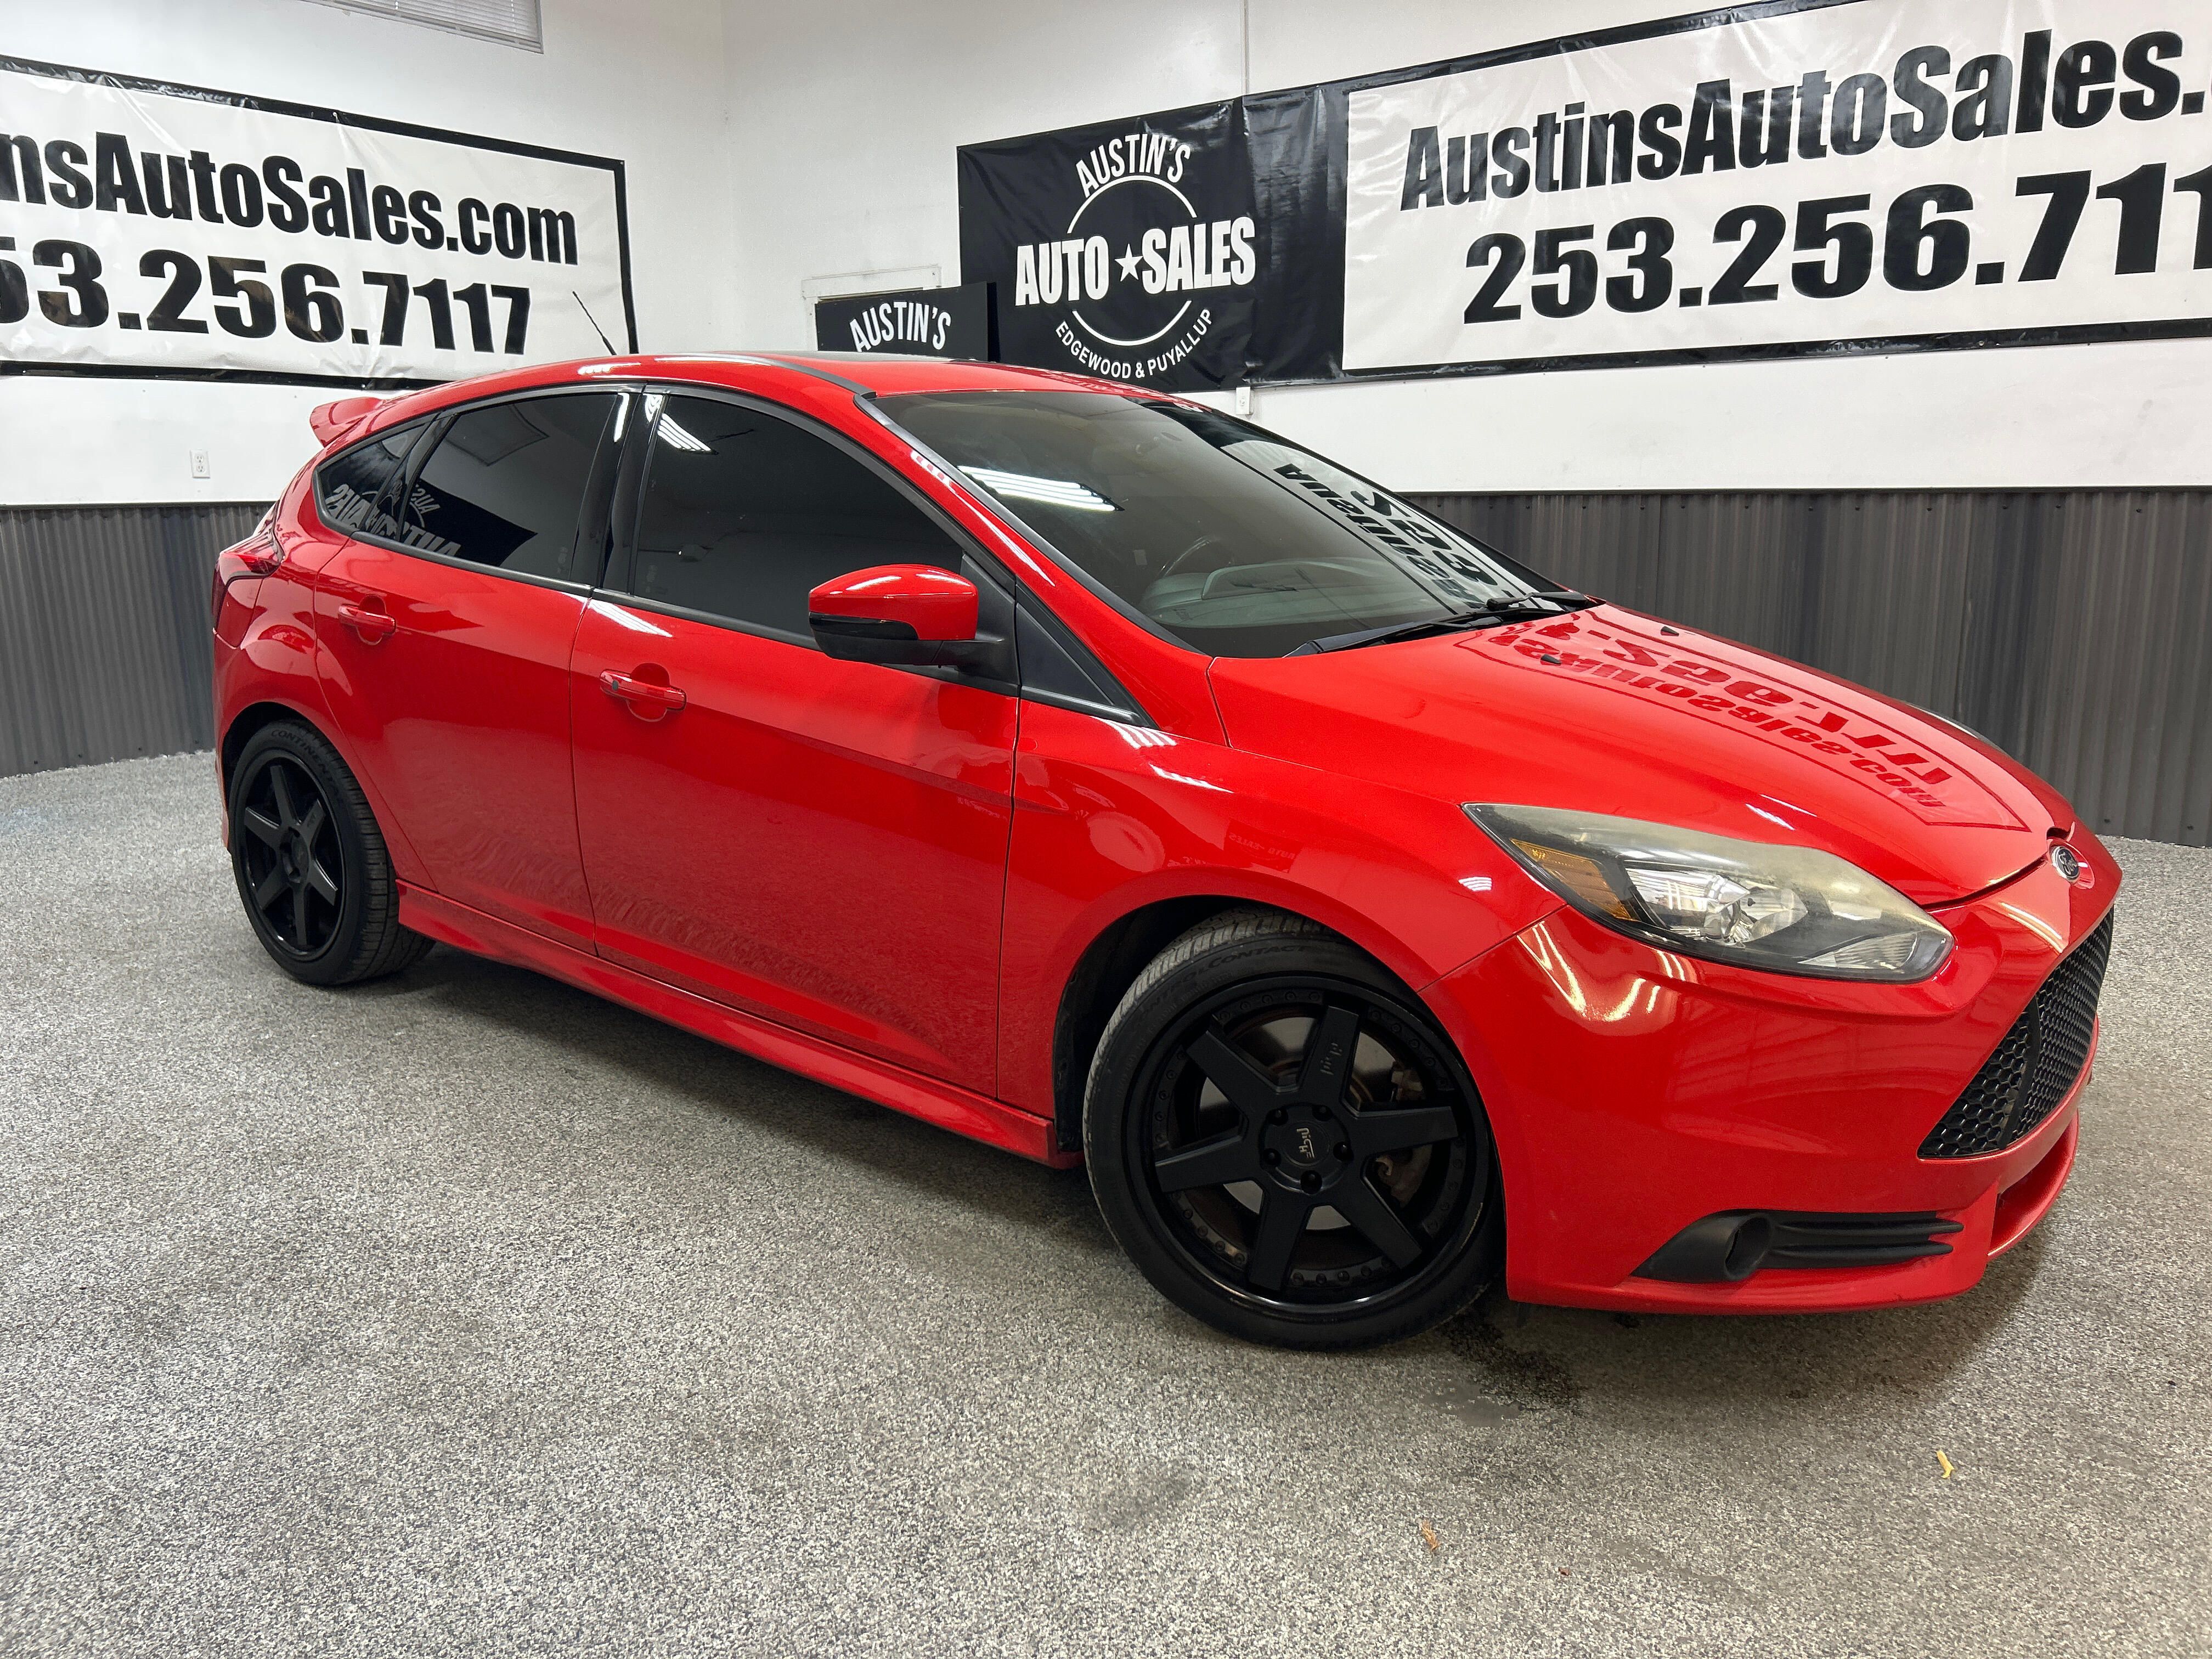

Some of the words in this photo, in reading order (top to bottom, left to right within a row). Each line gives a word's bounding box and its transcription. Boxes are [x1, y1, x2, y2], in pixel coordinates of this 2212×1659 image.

[1401, 29, 2212, 211] AustinsAutoSales.
[0, 132, 579, 266] nsAutoSales.com
[1076, 133, 1191, 198] AUSTIN'S
[1015, 235, 1109, 306] AUTO
[1142, 216, 1256, 295] SALES
[850, 301, 951, 353] AUSTIN'S
[1055, 321, 1131, 379] EDGEWOOD
[1135, 362, 1146, 379] &
[1147, 308, 1212, 376] PUYALLUP
